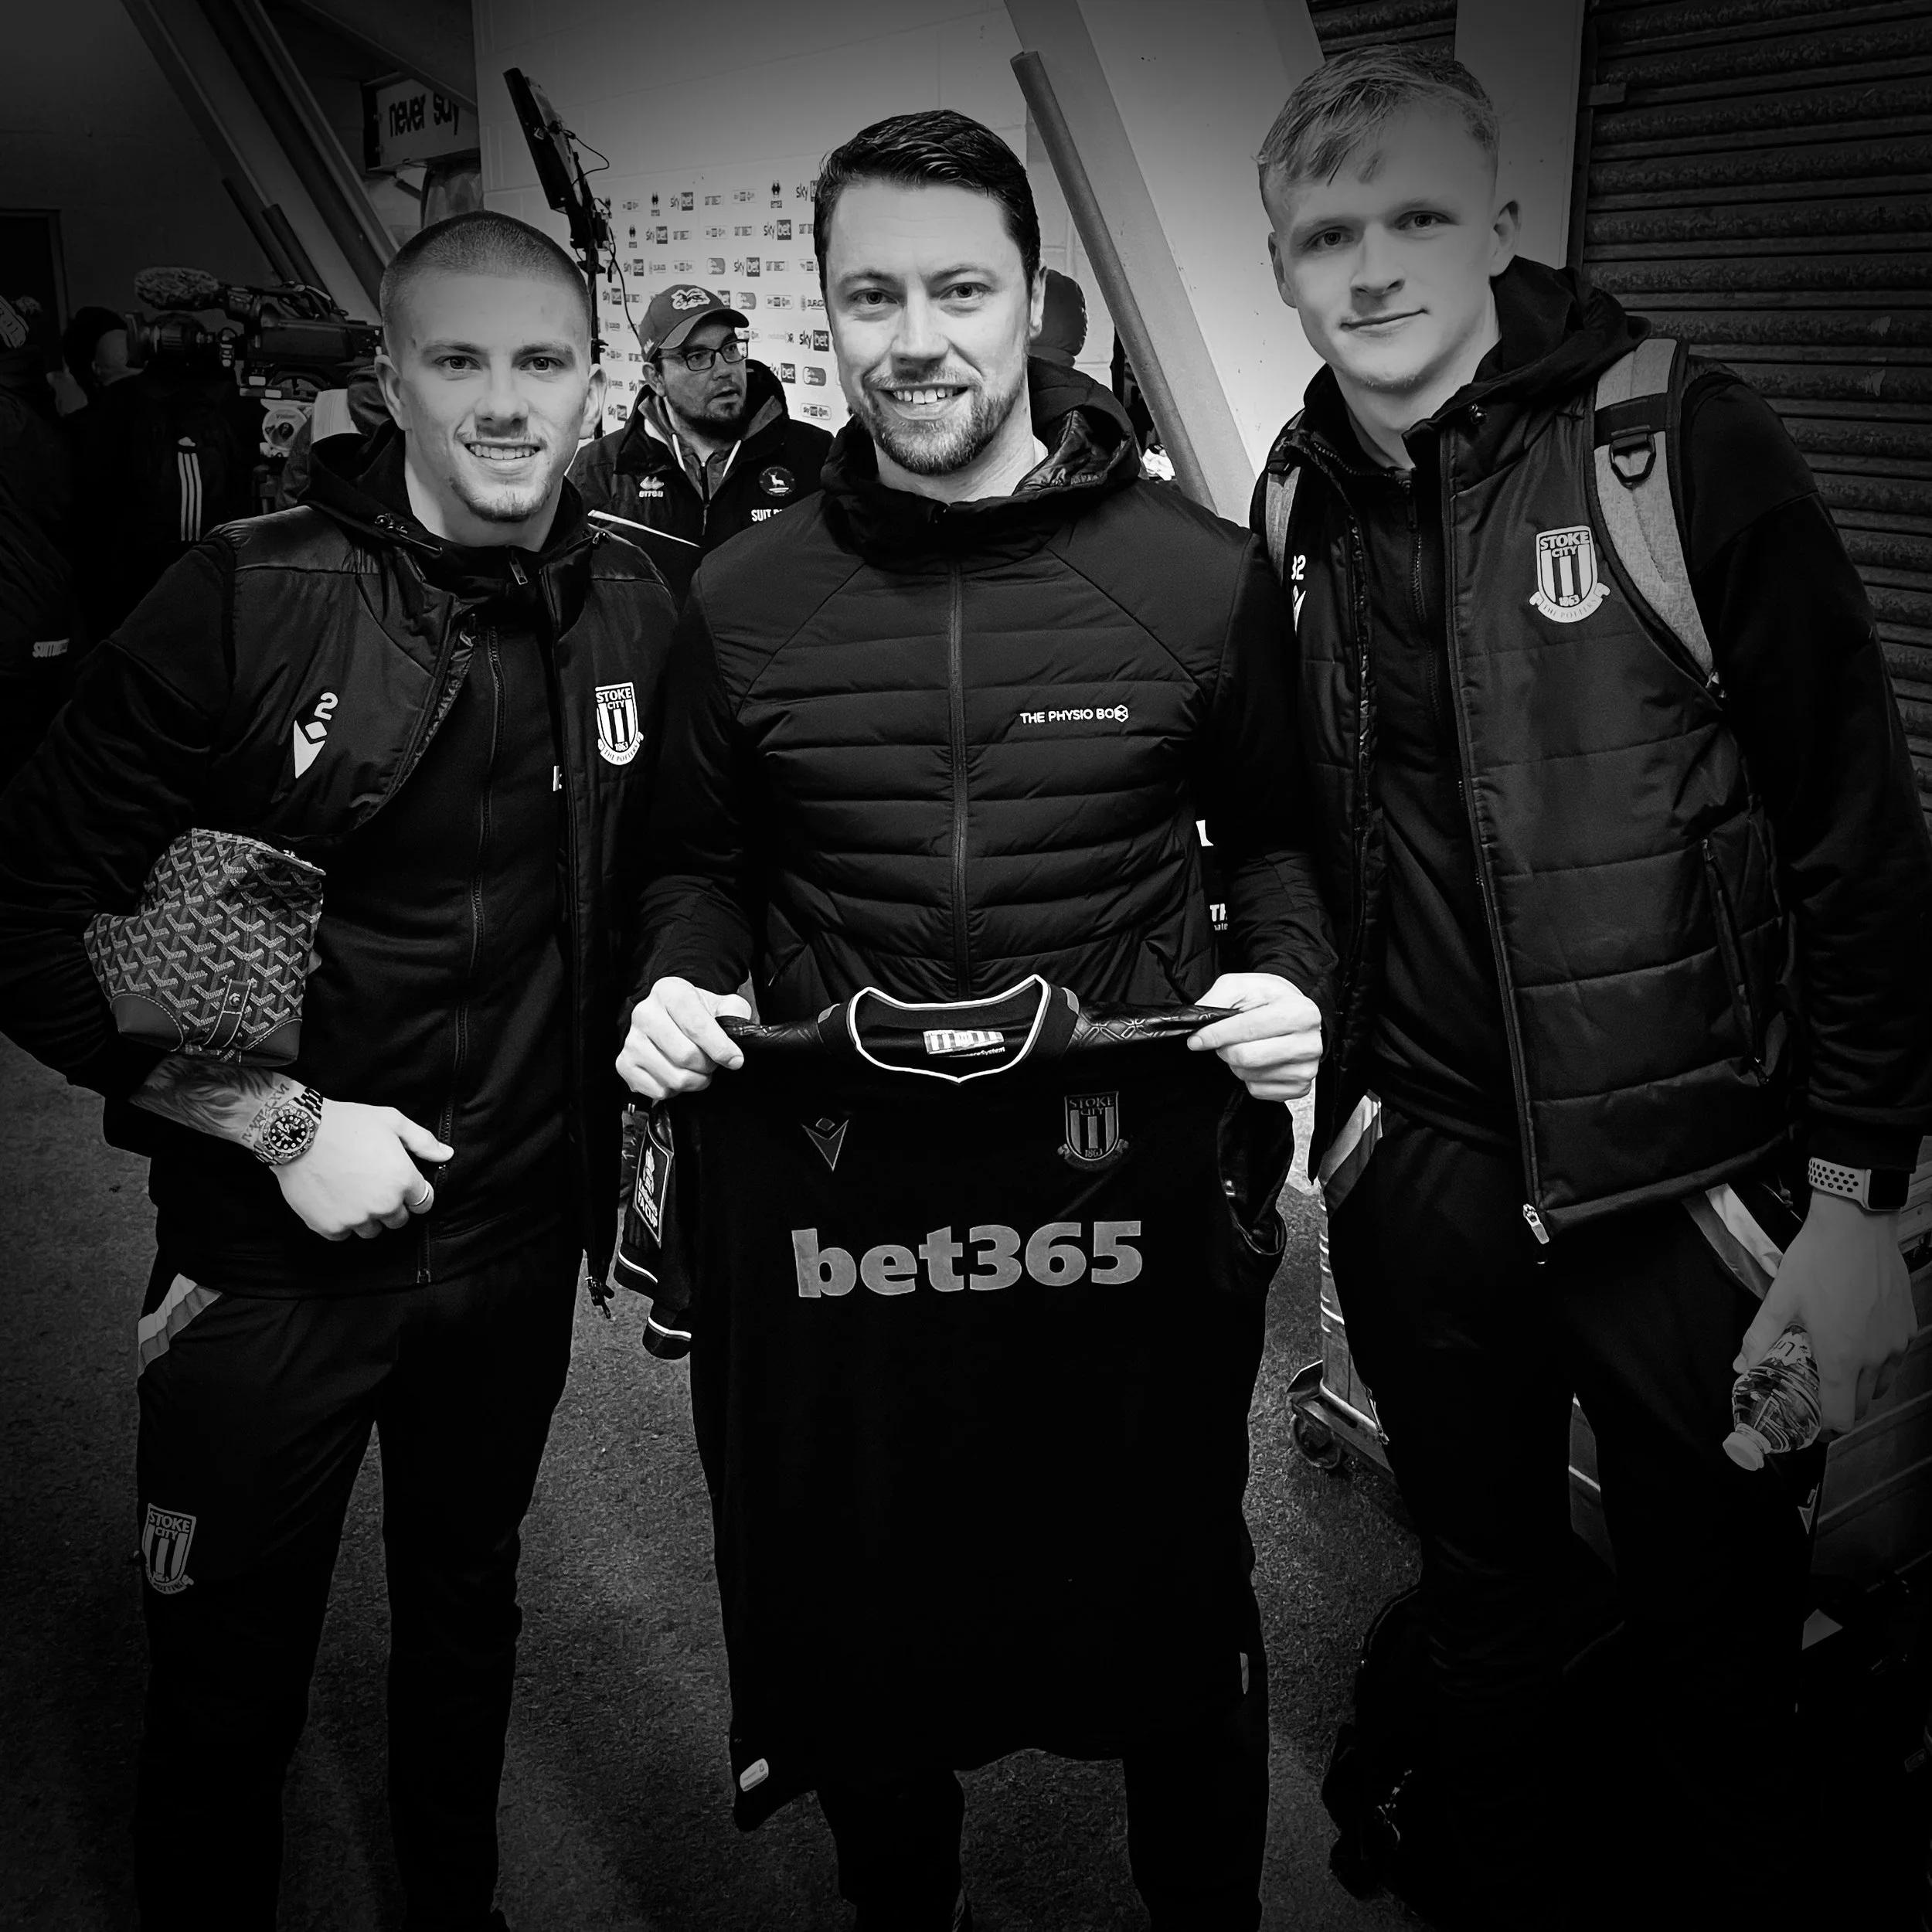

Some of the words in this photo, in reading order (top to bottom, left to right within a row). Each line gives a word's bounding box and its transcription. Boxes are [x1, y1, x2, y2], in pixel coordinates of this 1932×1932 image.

[389, 93, 426, 137] never
[750, 509, 772, 522] SUIT
[1539, 531, 1591, 551] STOKE
[1551, 546, 1578, 558] CITY
[595, 687, 632, 704] STOKE
[314, 692, 338, 721] 2
[607, 700, 625, 710] CITY
[1019, 712, 1046, 724] THE
[1048, 708, 1094, 722] PHYSIO
[1069, 1095, 1115, 1109] STOKE
[791, 1220, 1143, 1298] bet365
[148, 1509, 191, 1534] STOKE
[155, 1526, 179, 1541] CITY
